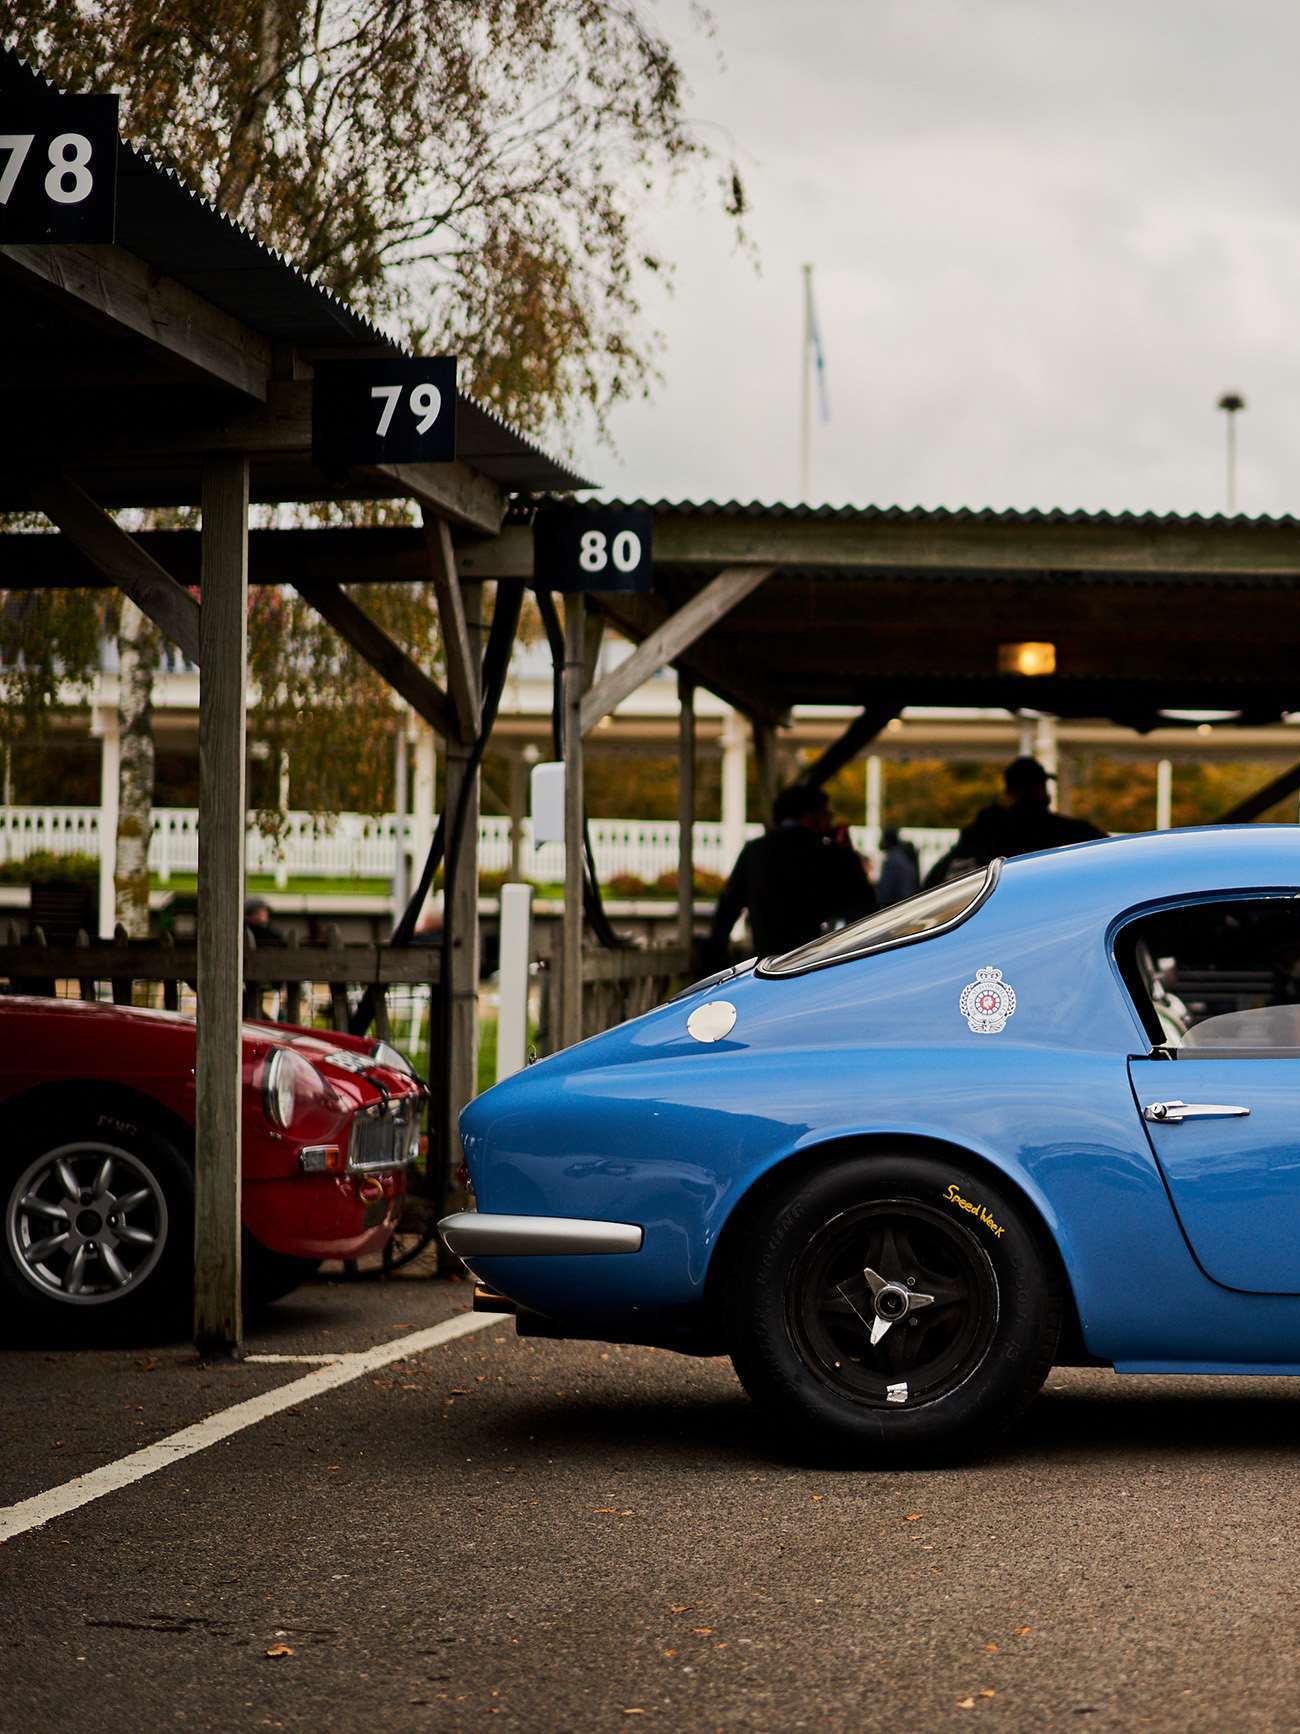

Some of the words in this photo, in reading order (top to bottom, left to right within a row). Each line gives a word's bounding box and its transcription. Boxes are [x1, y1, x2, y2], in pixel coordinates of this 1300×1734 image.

[0, 132, 93, 205] 78
[371, 383, 442, 437] 79
[579, 530, 642, 572] 80
